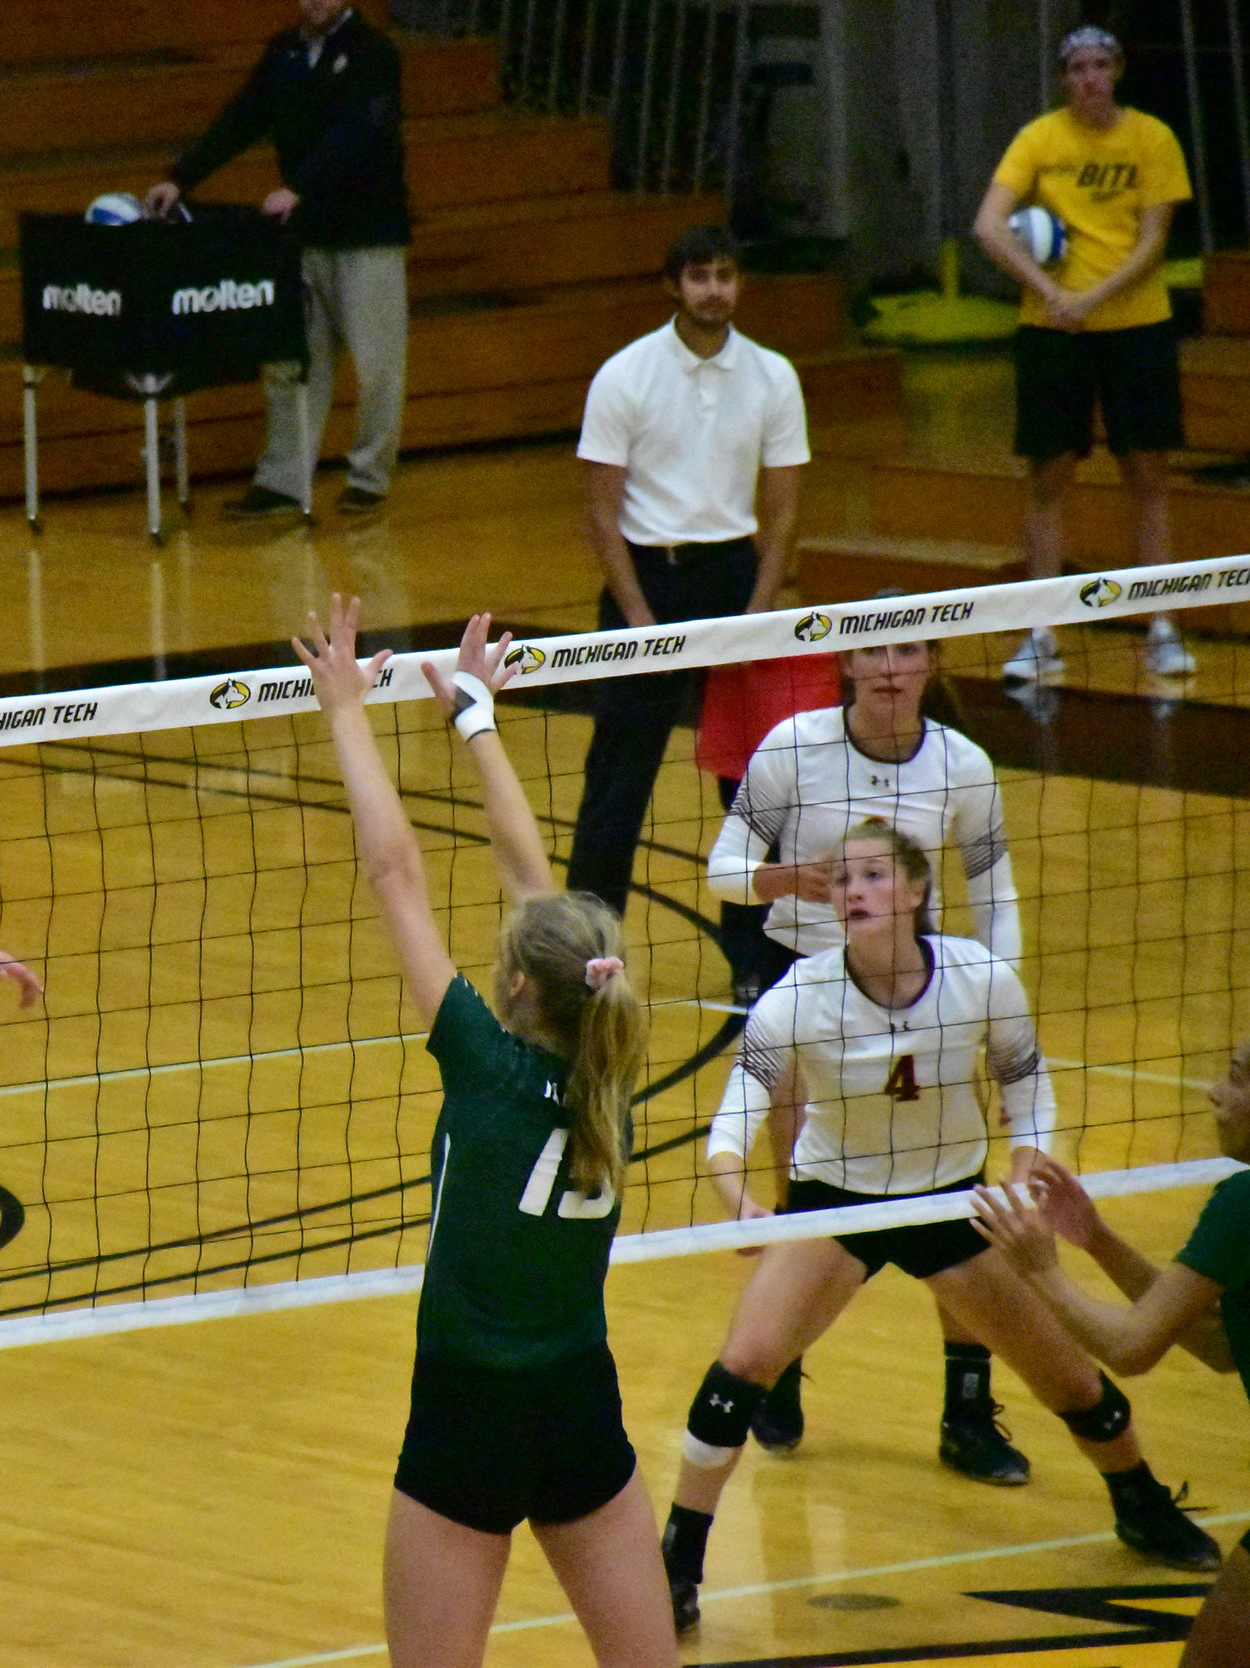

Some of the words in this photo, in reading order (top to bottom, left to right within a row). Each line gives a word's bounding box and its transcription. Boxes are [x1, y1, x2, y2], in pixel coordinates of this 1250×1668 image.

[43, 283, 122, 316] molten
[172, 278, 275, 315] molten
[1128, 573, 1213, 600] MICHIGAN
[839, 607, 926, 635] MICHIGAN
[931, 602, 974, 623] TECH
[551, 641, 638, 668] MICHIGAN
[644, 635, 686, 657] TECH
[53, 702, 98, 724] TECH
[883, 1054, 920, 1102] 4
